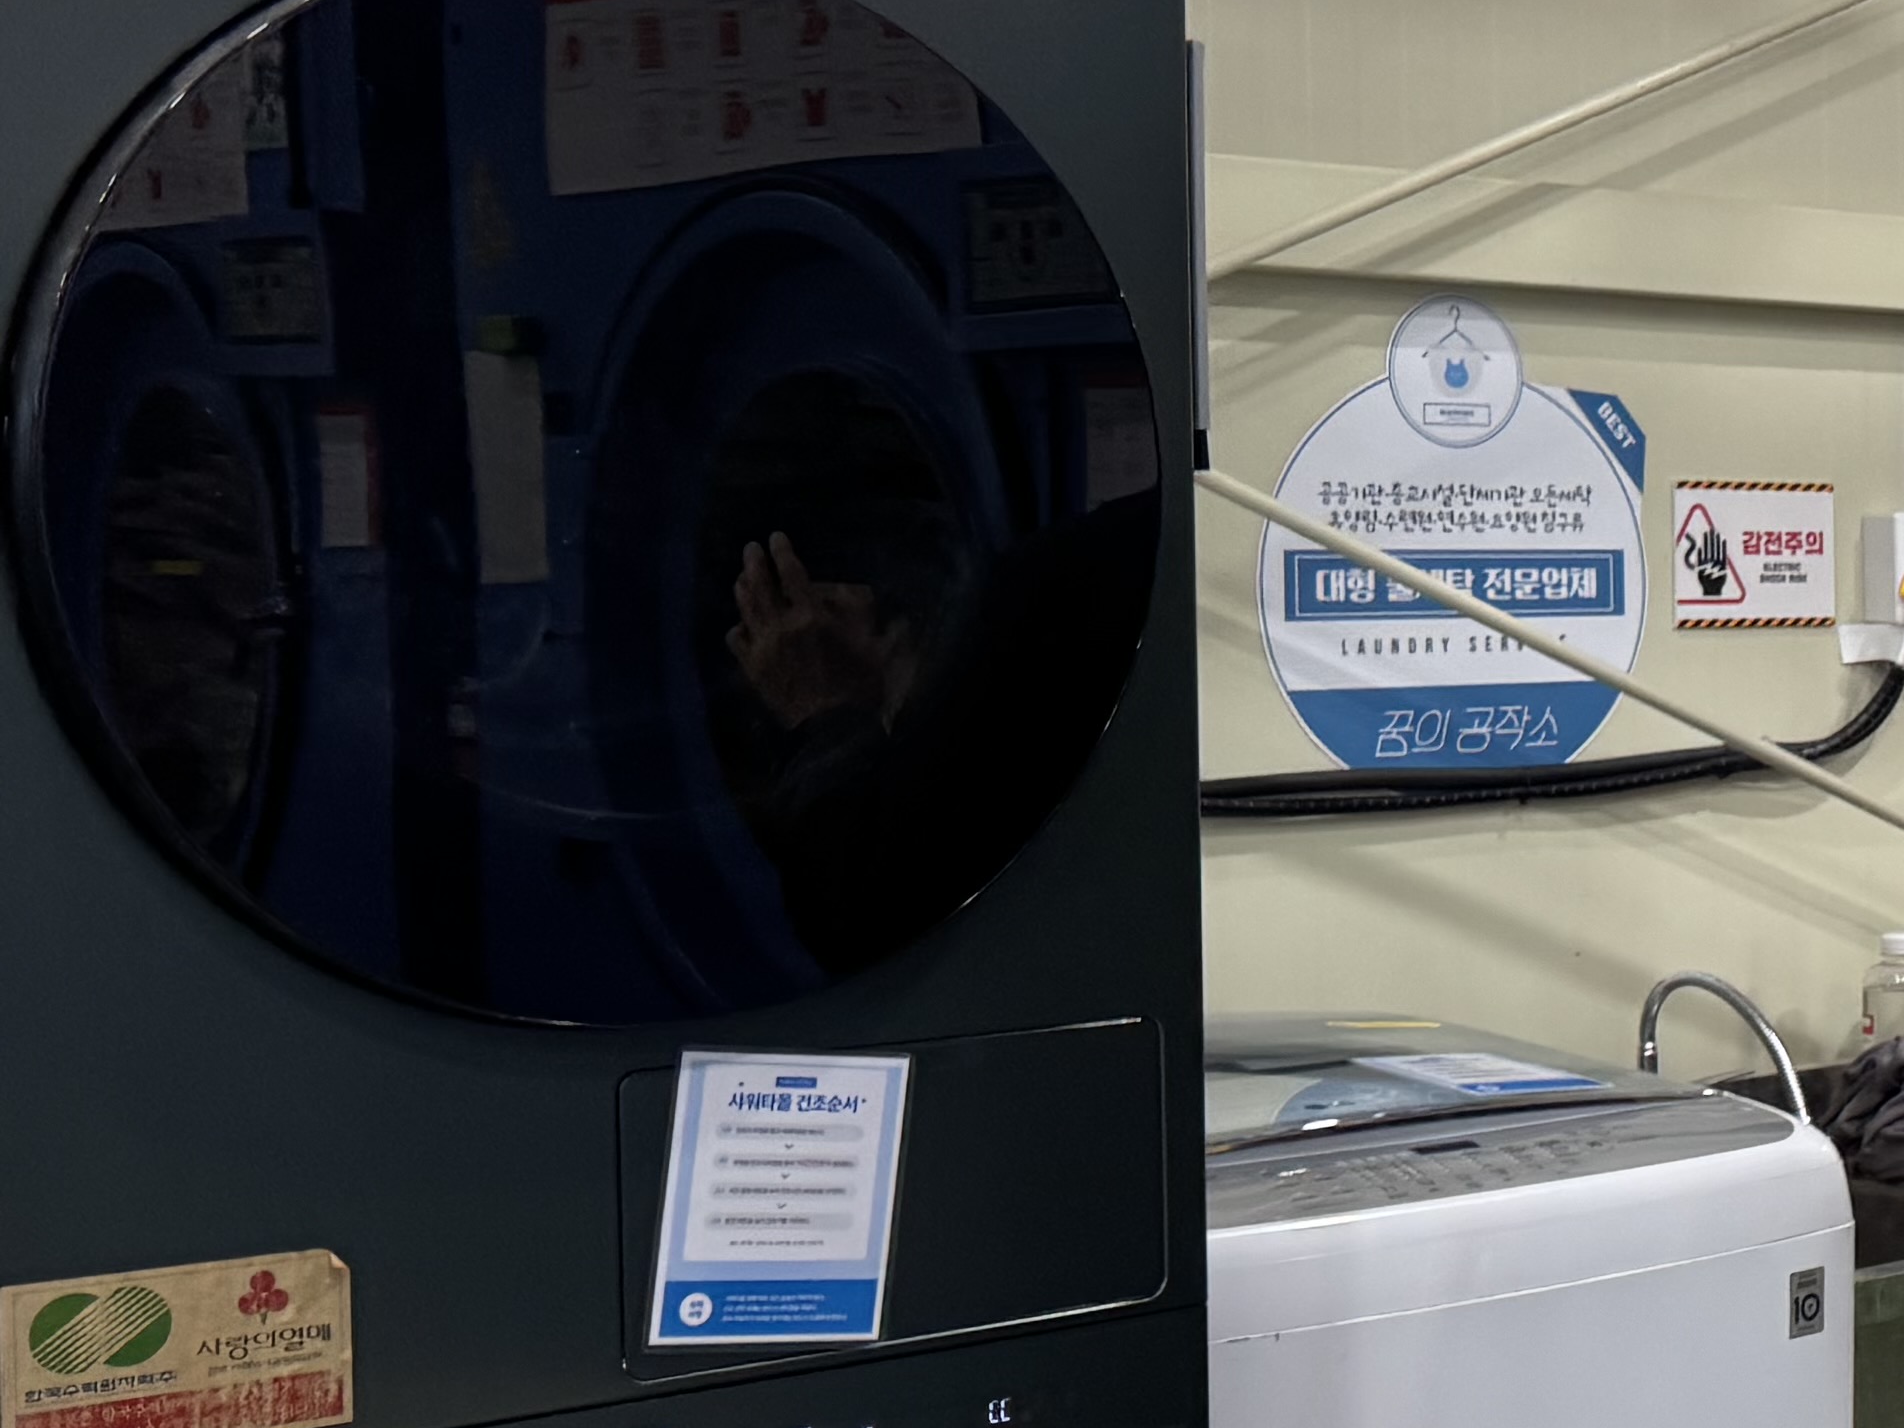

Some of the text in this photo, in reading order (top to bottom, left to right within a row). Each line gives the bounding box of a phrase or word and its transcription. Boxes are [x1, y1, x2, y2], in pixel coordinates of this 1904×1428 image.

[1598, 401, 1637, 449] BEST
[1742, 530, 1825, 556] 감전주의
[1763, 562, 1801, 572] ELECTRIC
[1315, 566, 1598, 604] 대형 전문업체
[1341, 636, 1451, 657] LAUNDRY
[1375, 705, 1559, 759] 꿈의 공작소
[796, 1093, 860, 1114] 건조순서
[196, 1324, 332, 1361] 사랑의열매
